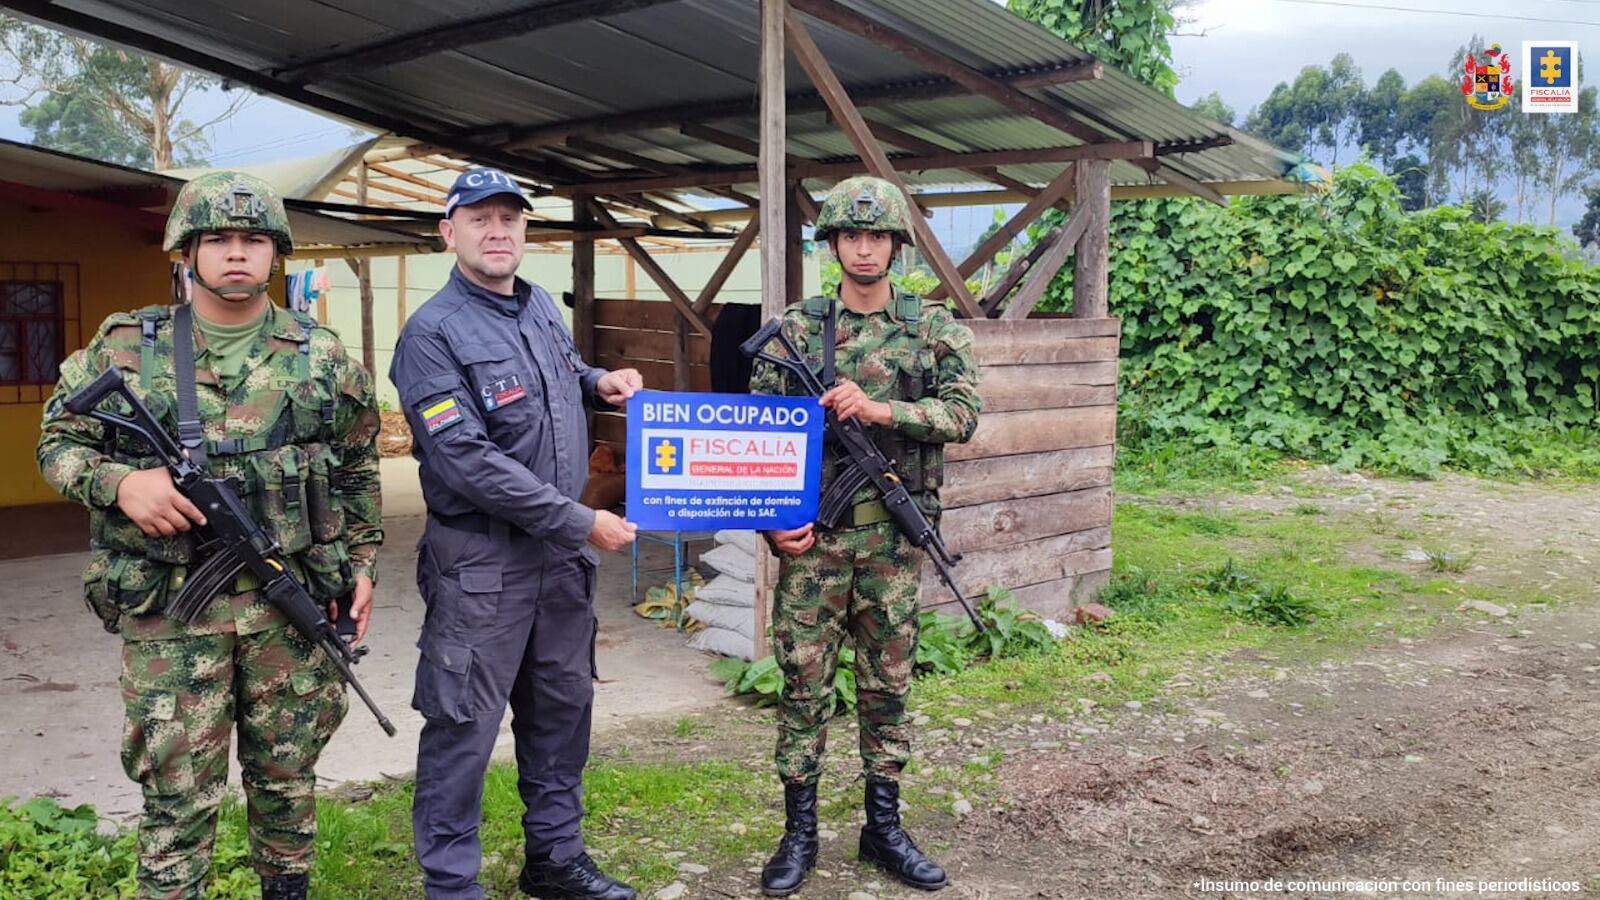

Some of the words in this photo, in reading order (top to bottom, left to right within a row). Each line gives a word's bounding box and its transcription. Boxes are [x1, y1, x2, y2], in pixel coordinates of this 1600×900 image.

[466, 170, 514, 188] CTI
[643, 403, 690, 422] BIEN
[696, 404, 808, 426] OCUPADO
[690, 436, 797, 456] FISCALÍA
[692, 465, 734, 474] GENERAL
[736, 465, 748, 474] DE
[750, 465, 762, 474] LA
[763, 464, 795, 475] NACIÓN
[643, 496, 662, 505] con
[664, 495, 687, 505] fines
[689, 495, 702, 505] de
[705, 495, 748, 506] extinción
[750, 496, 762, 506] de
[764, 496, 801, 506] dominio
[668, 509, 675, 517] a
[678, 507, 731, 519] disposición
[733, 508, 745, 517] de
[747, 508, 757, 517] la
[758, 508, 777, 517] SAE.
